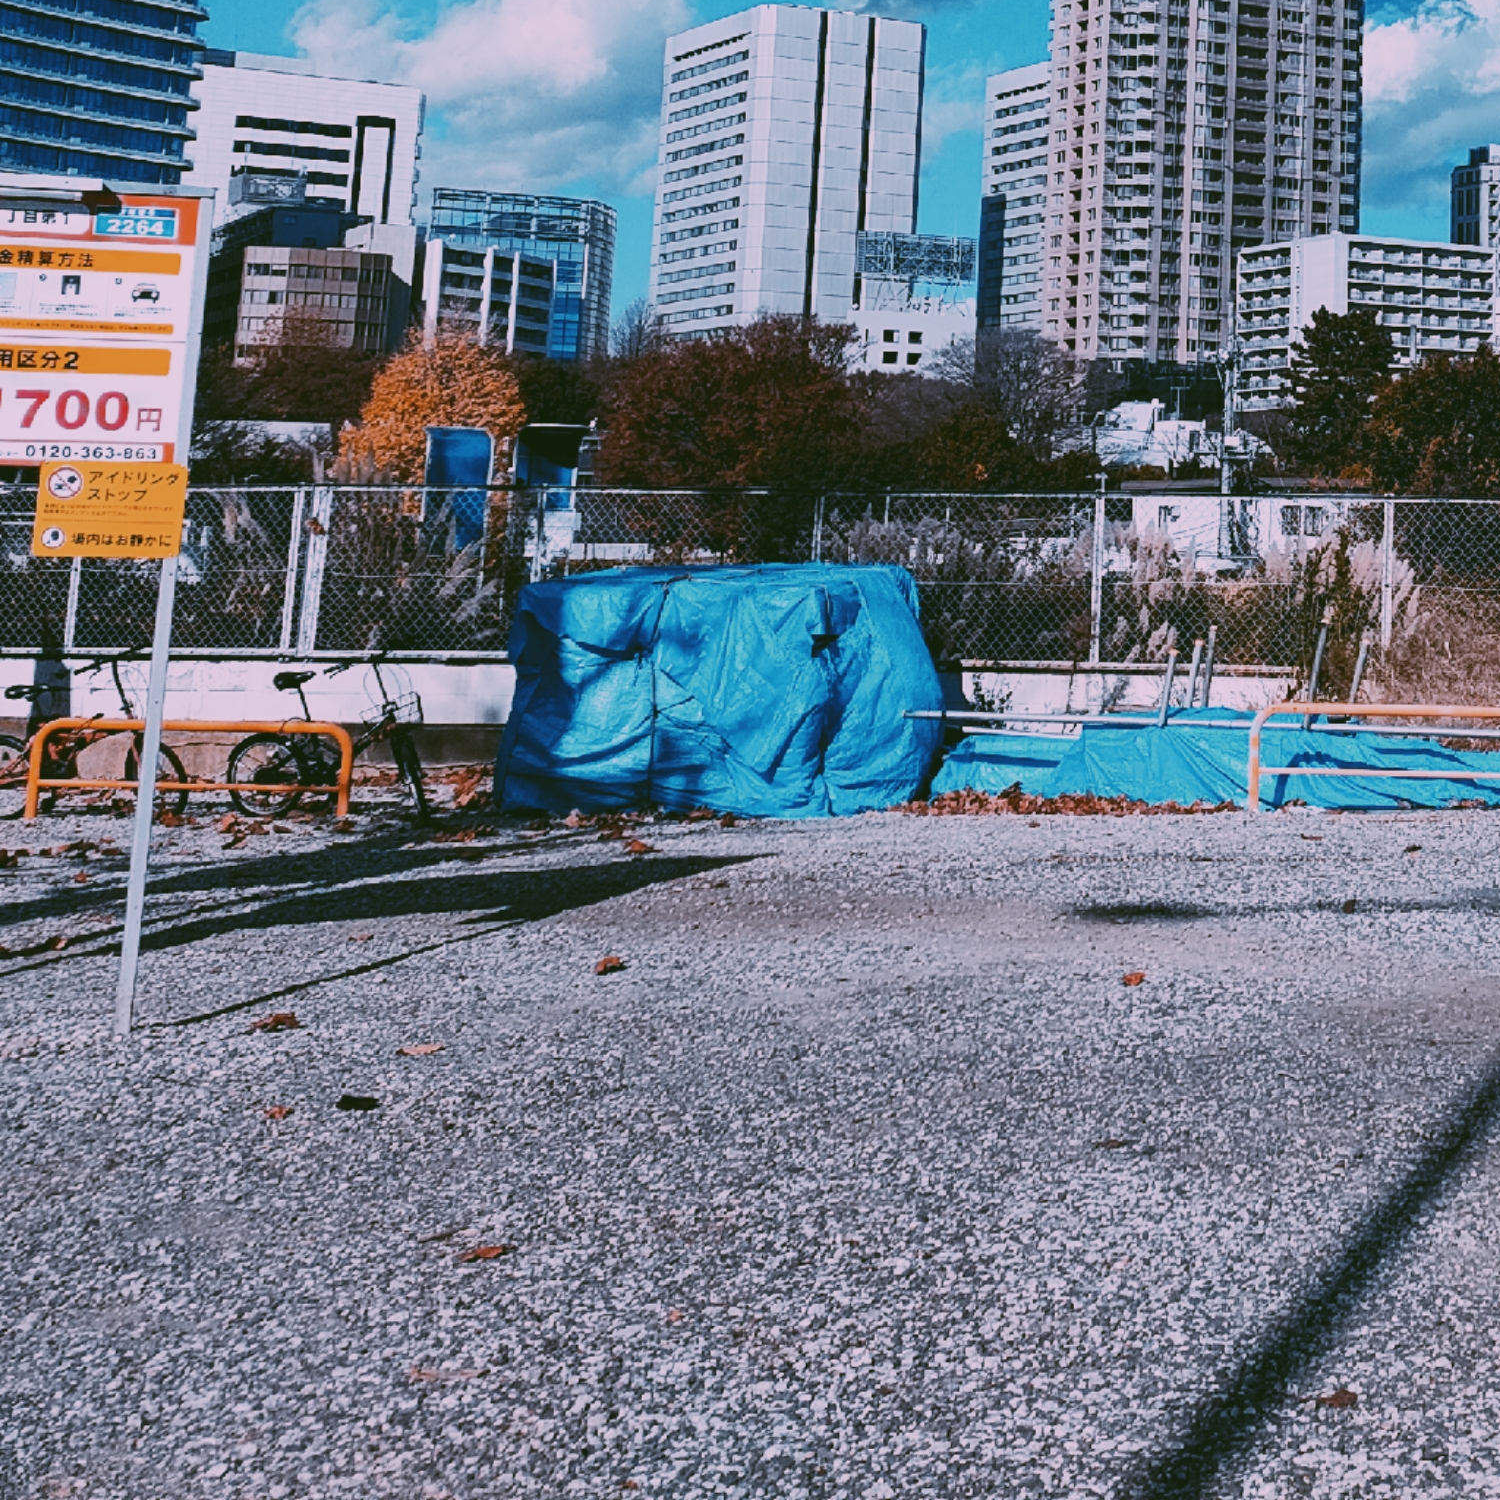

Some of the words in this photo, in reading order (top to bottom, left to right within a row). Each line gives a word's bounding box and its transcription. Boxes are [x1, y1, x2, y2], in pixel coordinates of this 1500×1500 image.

[106, 219, 164, 235] 2264
[0, 389, 163, 432] 700円
[25, 444, 157, 459] 0120-363-863
[87, 488, 148, 502] ストップ
[71, 533, 173, 547] 場内はお静かに
